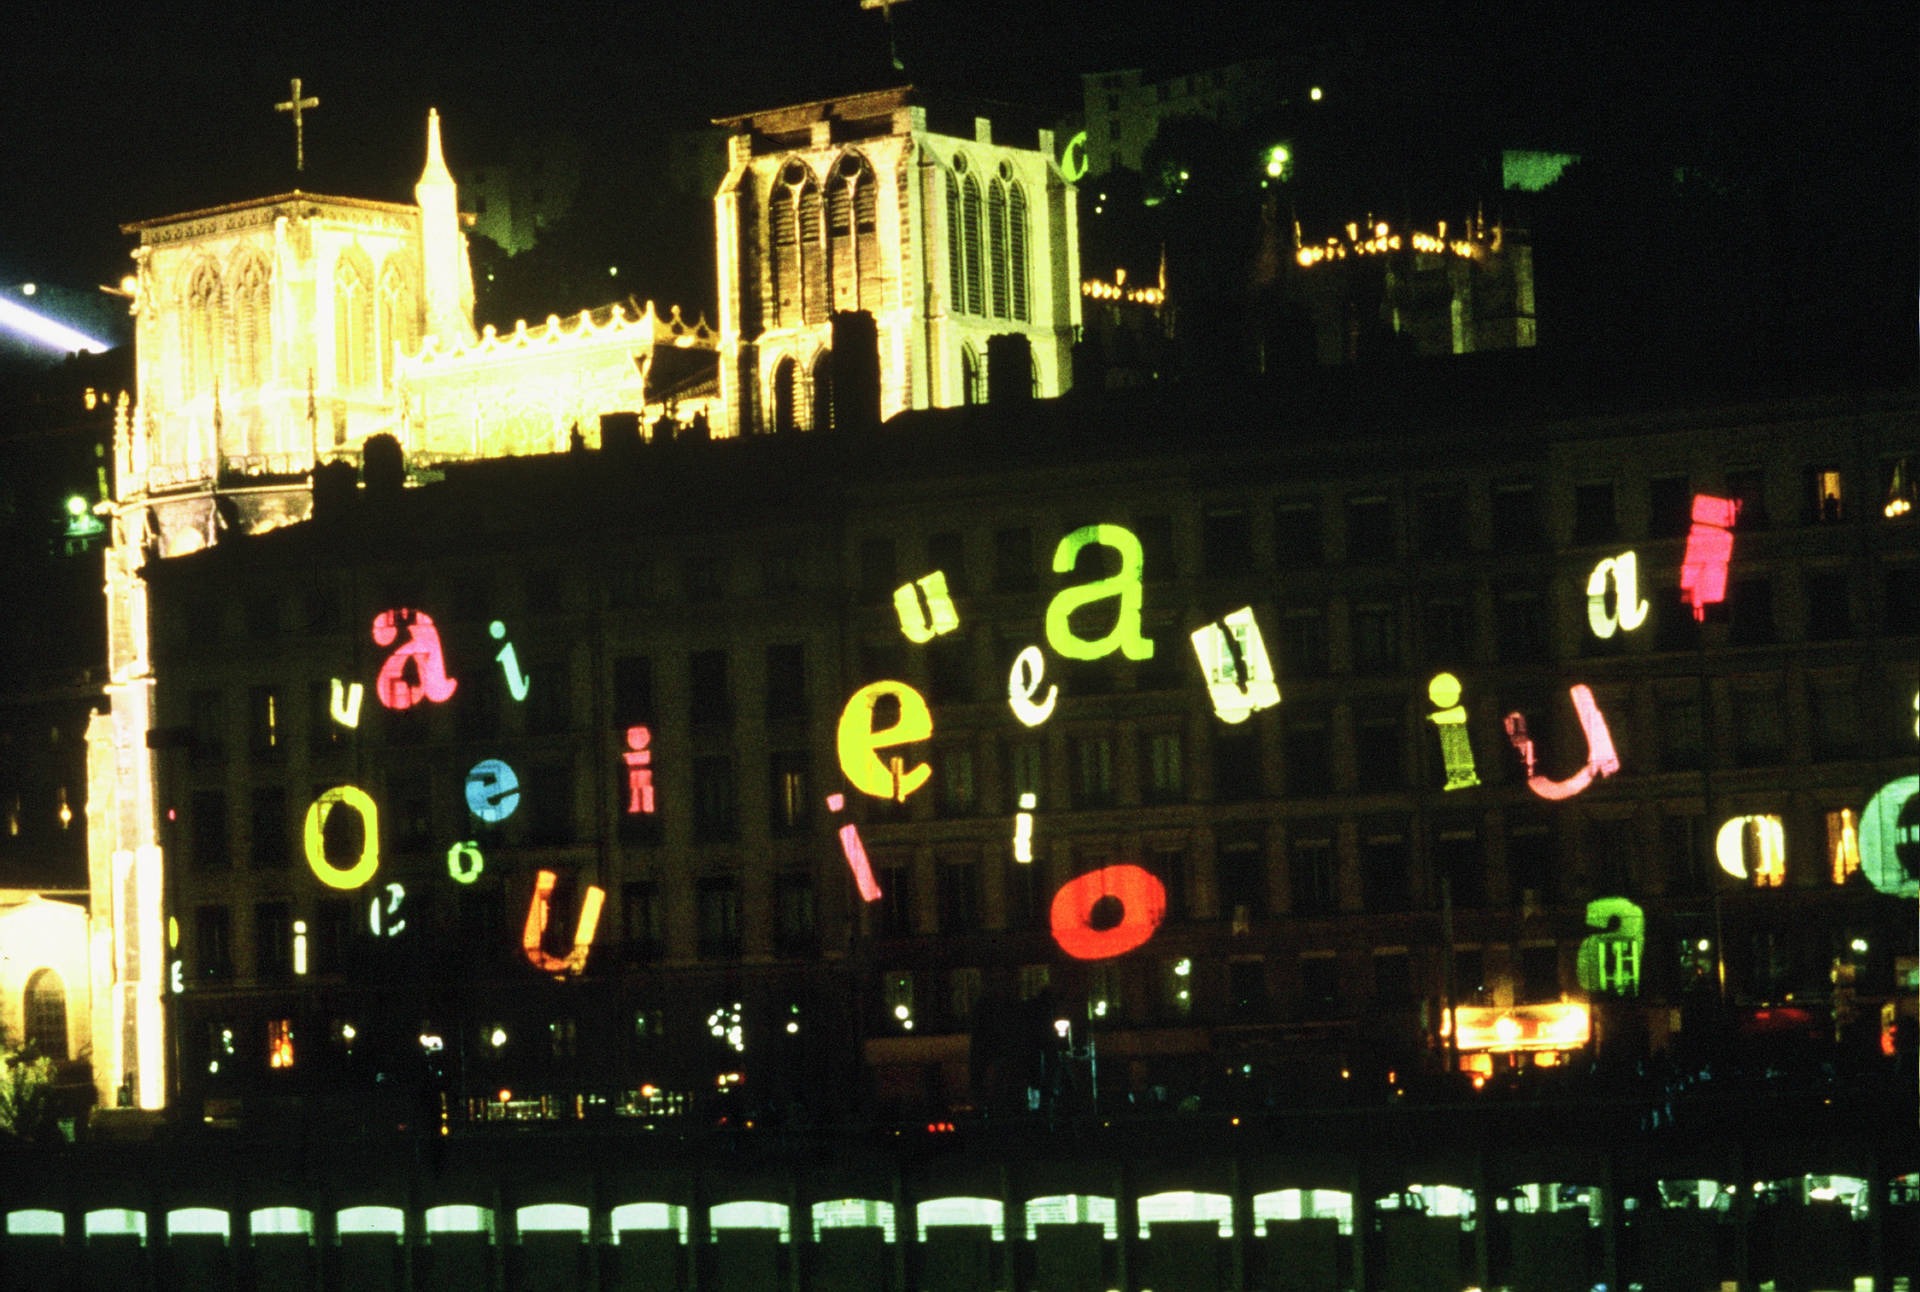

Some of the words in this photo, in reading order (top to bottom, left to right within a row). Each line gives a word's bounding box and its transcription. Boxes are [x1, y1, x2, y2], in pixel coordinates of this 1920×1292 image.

[893, 570, 960, 645] u
[1045, 523, 1155, 661] a
[1585, 550, 1650, 639] a
[371, 608, 458, 711] a
[489, 620, 530, 701] i
[1007, 645, 1059, 728] e
[1189, 605, 1282, 725] u
[622, 725, 655, 814] i
[835, 679, 935, 804] e
[1426, 672, 1481, 791] i
[465, 759, 521, 823] e
[1011, 792, 1037, 864] i
[825, 792, 882, 903] i
[293, 919, 308, 975] i
